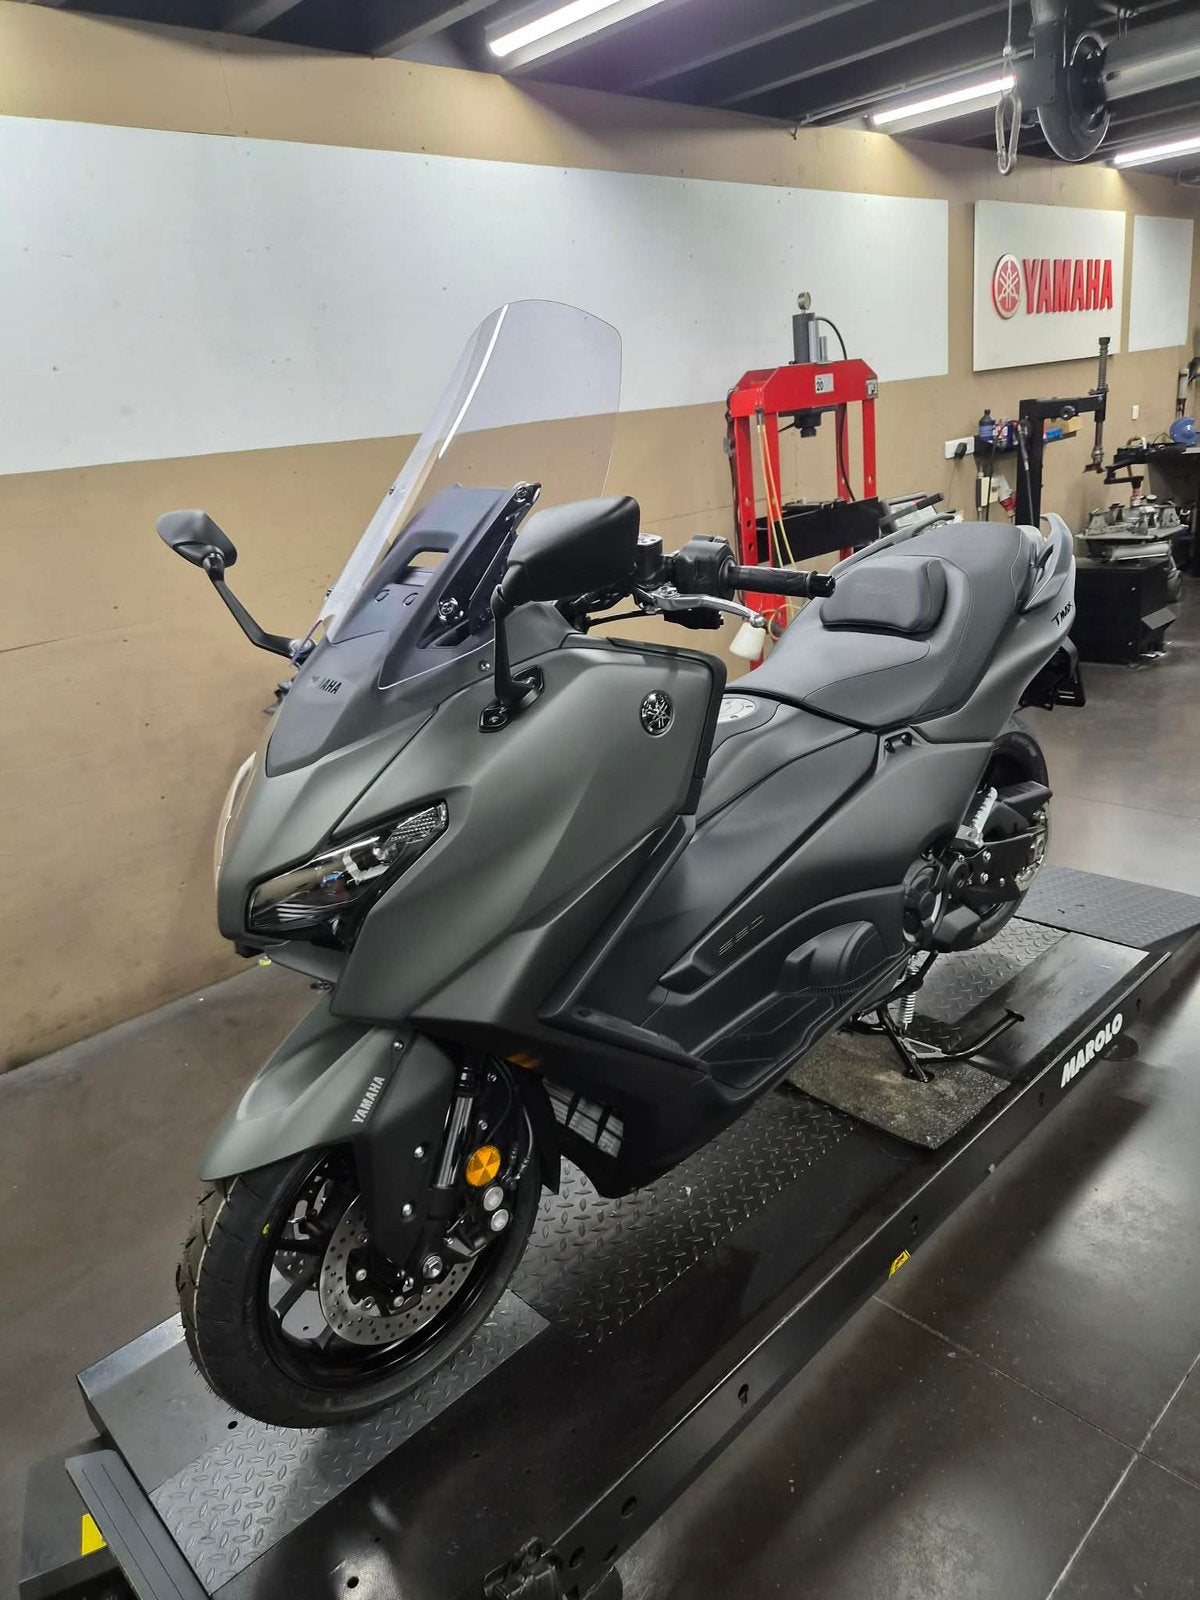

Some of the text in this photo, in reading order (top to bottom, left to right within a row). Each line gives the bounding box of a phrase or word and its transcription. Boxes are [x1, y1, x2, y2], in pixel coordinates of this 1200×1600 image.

[1023, 258, 1113, 315] YAMAHA
[815, 380, 824, 392] 20
[1061, 1013, 1123, 1088] MAROLO
[351, 1075, 386, 1123] YAMAHA
